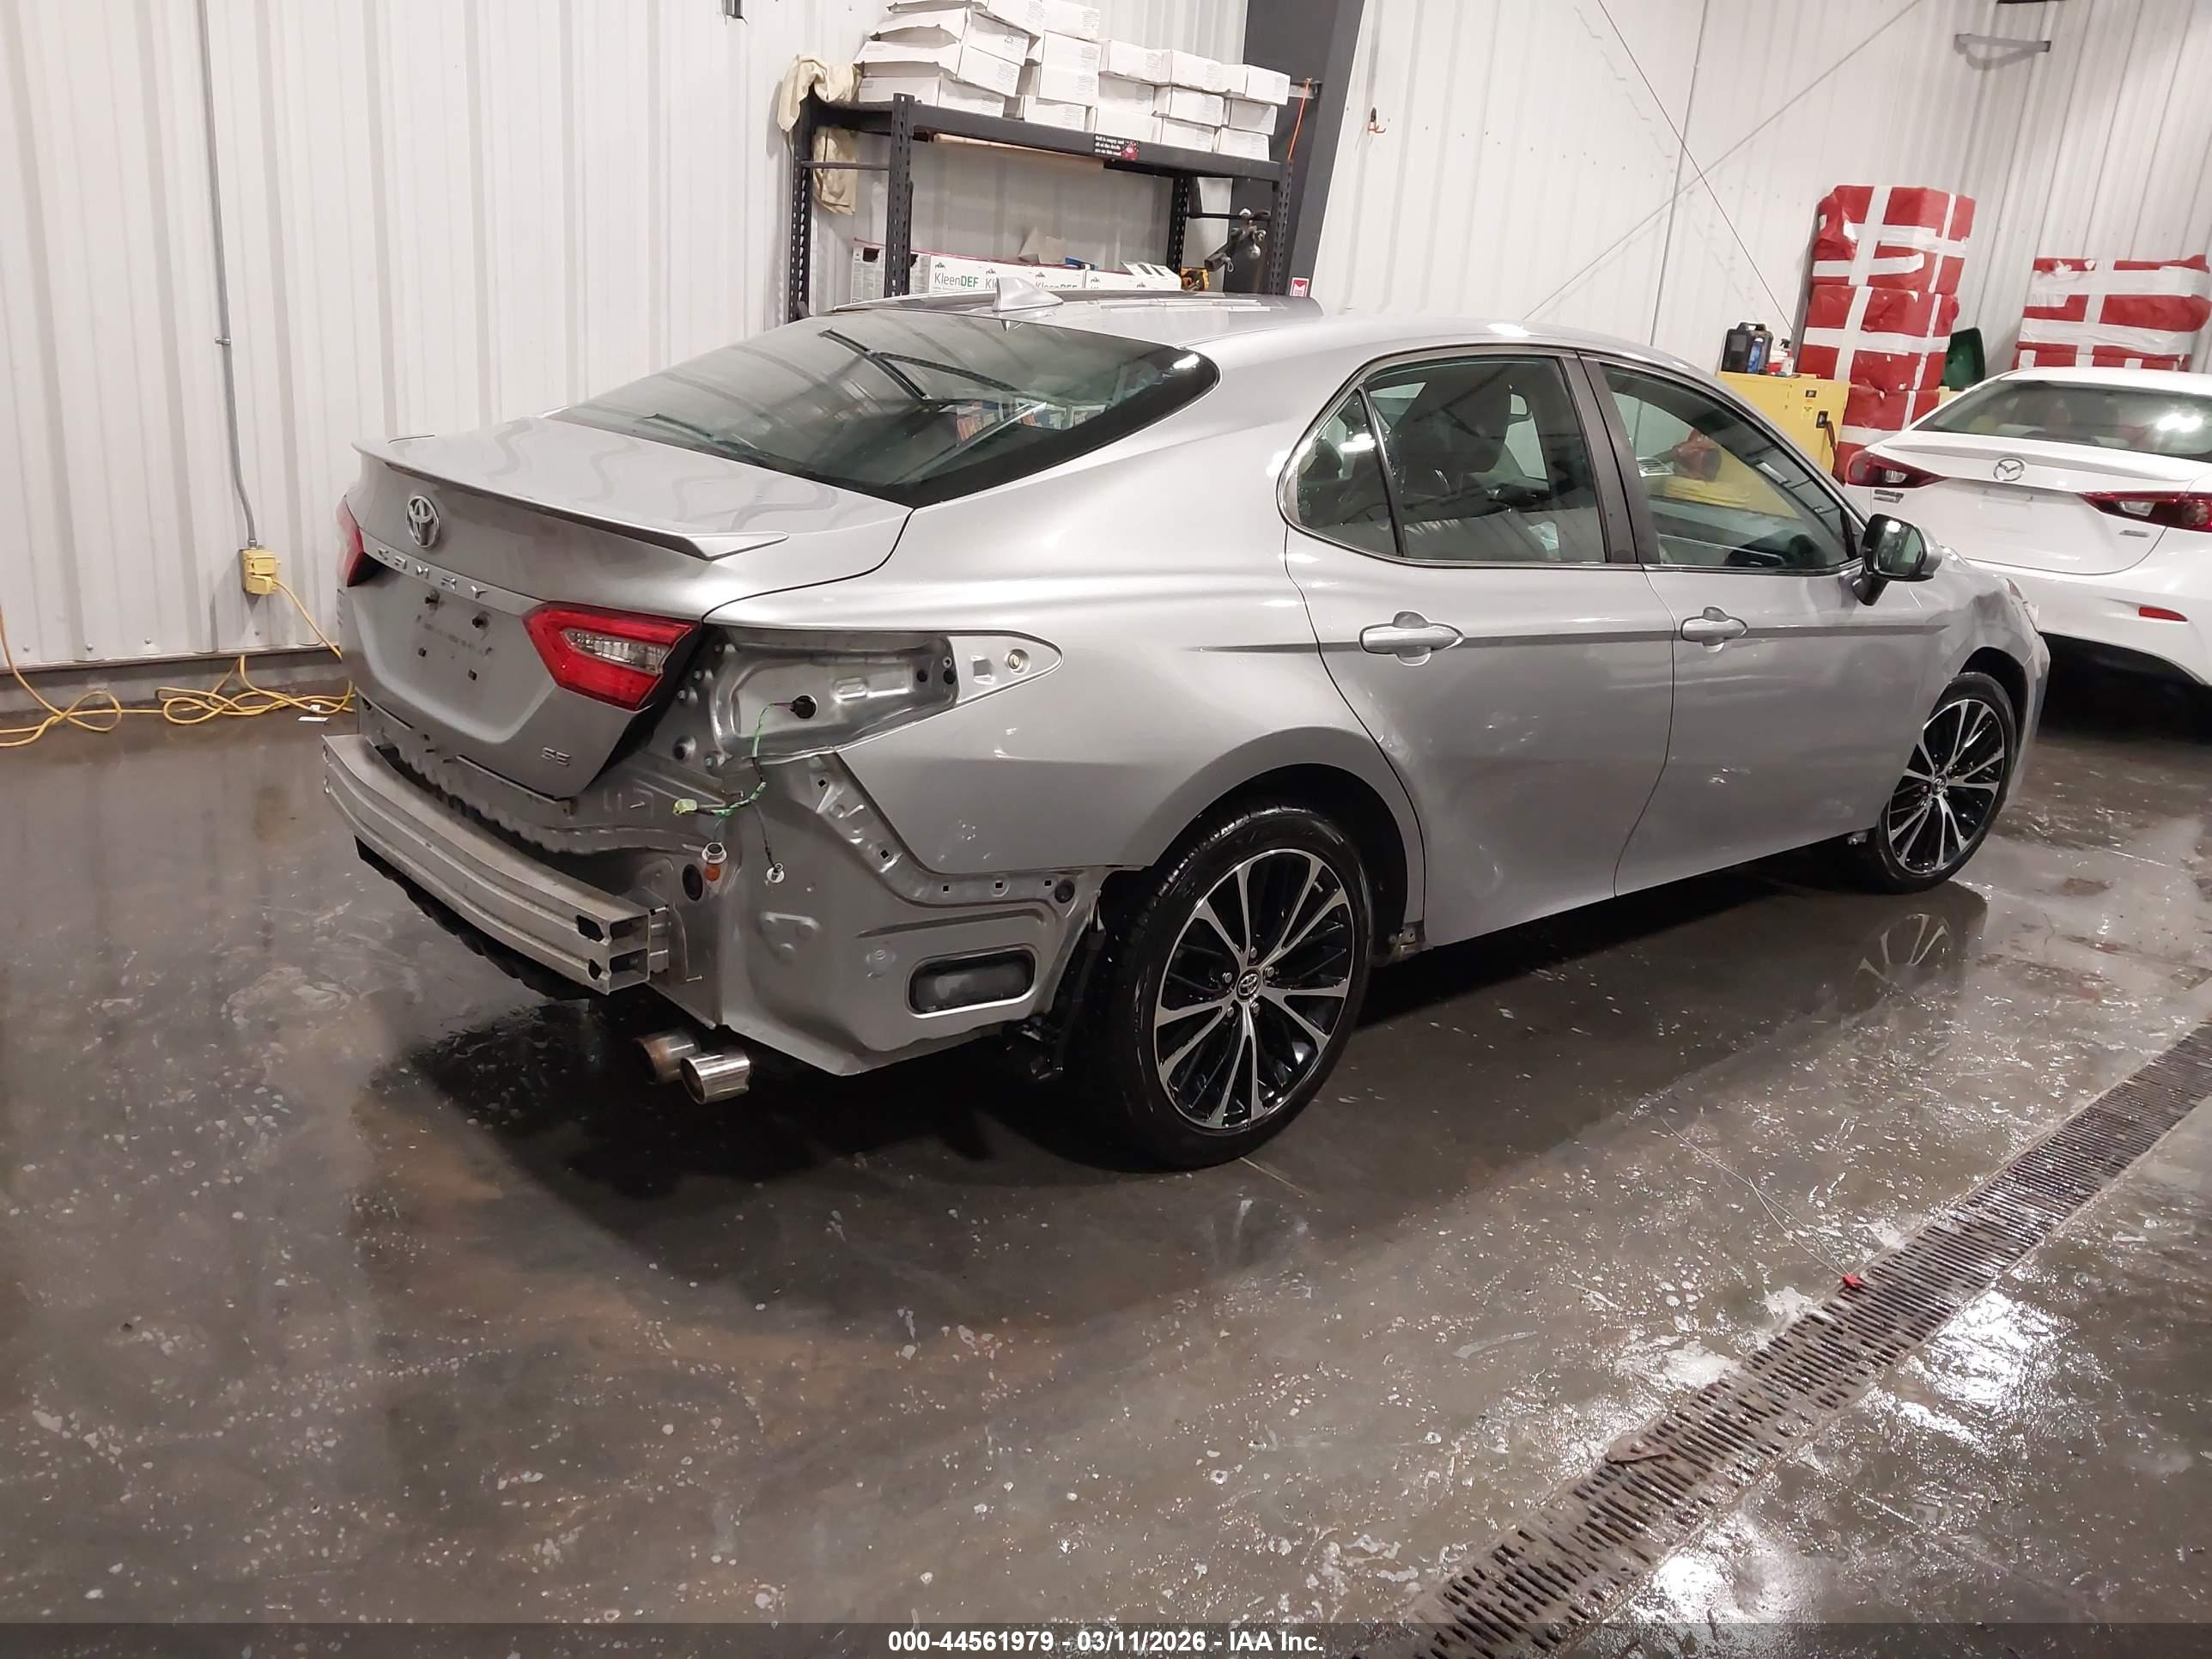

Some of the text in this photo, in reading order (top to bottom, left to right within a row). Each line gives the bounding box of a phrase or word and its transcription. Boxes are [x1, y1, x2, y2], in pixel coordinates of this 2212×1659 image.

[934, 272, 979, 288] KleenDEF
[378, 548, 488, 599] CAMRY
[542, 747, 570, 766] SE
